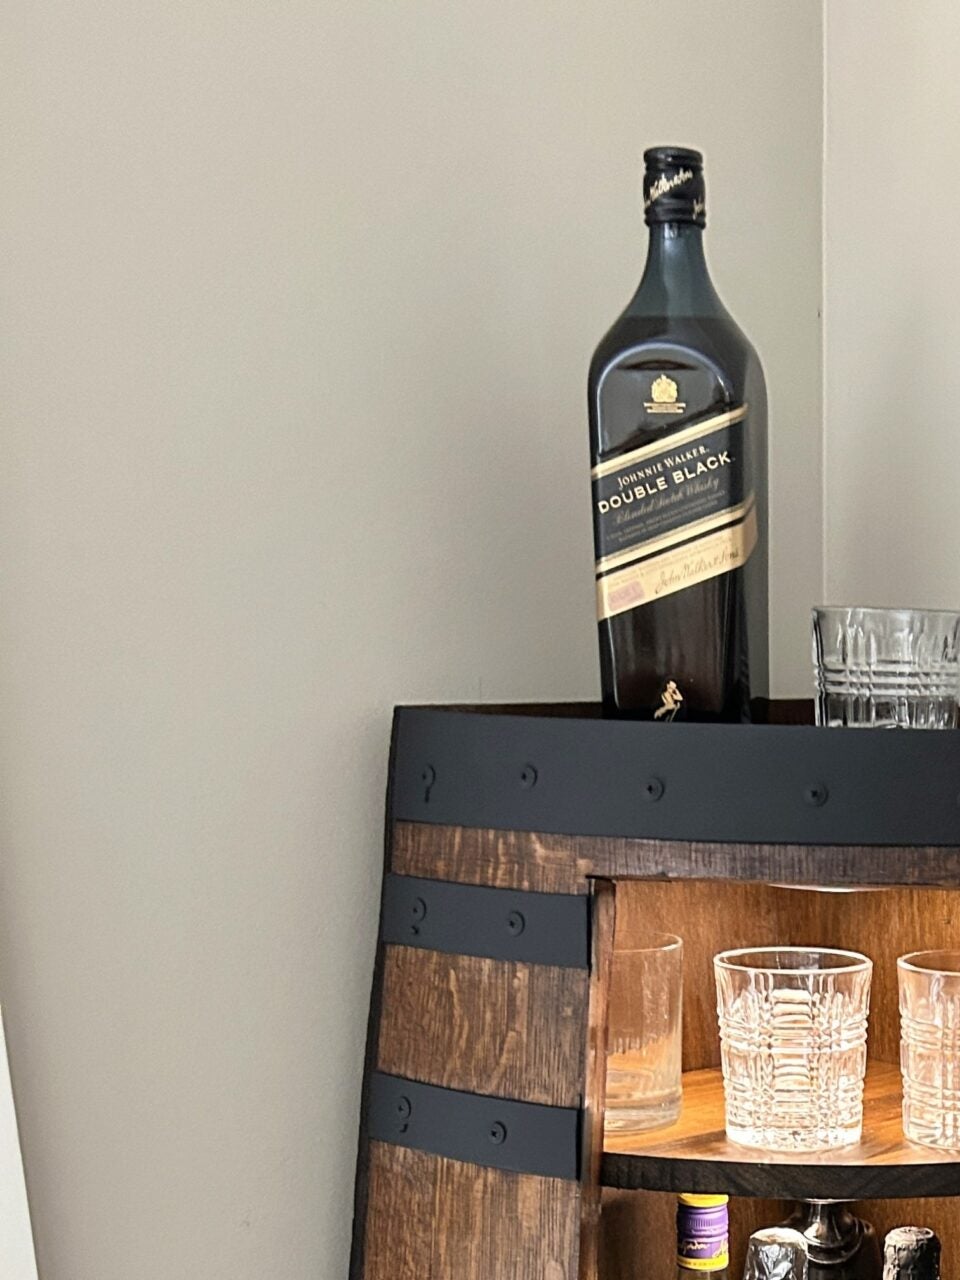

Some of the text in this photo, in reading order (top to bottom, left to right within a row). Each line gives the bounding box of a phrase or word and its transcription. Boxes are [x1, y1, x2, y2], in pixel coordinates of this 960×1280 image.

[597, 451, 731, 514] DOUBLE BLACK
[618, 445, 707, 490] JOHNNIE WALKER
